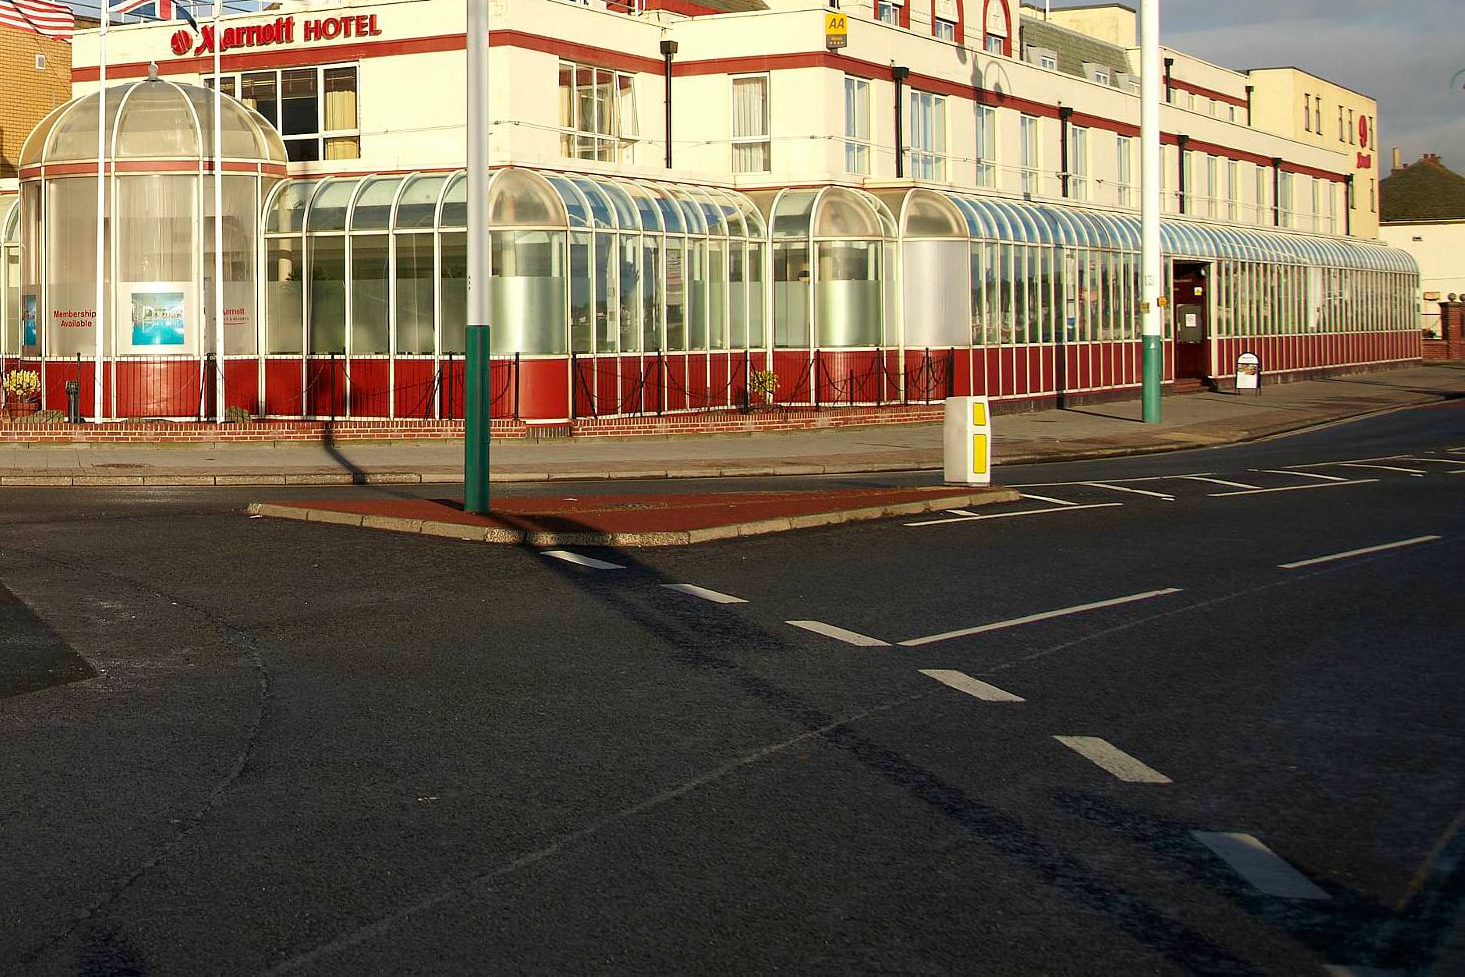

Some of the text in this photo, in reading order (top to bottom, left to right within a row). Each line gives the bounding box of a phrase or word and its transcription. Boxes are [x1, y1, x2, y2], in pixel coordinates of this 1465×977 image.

[828, 17, 844, 29] AA
[193, 14, 383, 57] Marriott HOTEL
[53, 310, 97, 319] Membership
[61, 319, 93, 328] Available
